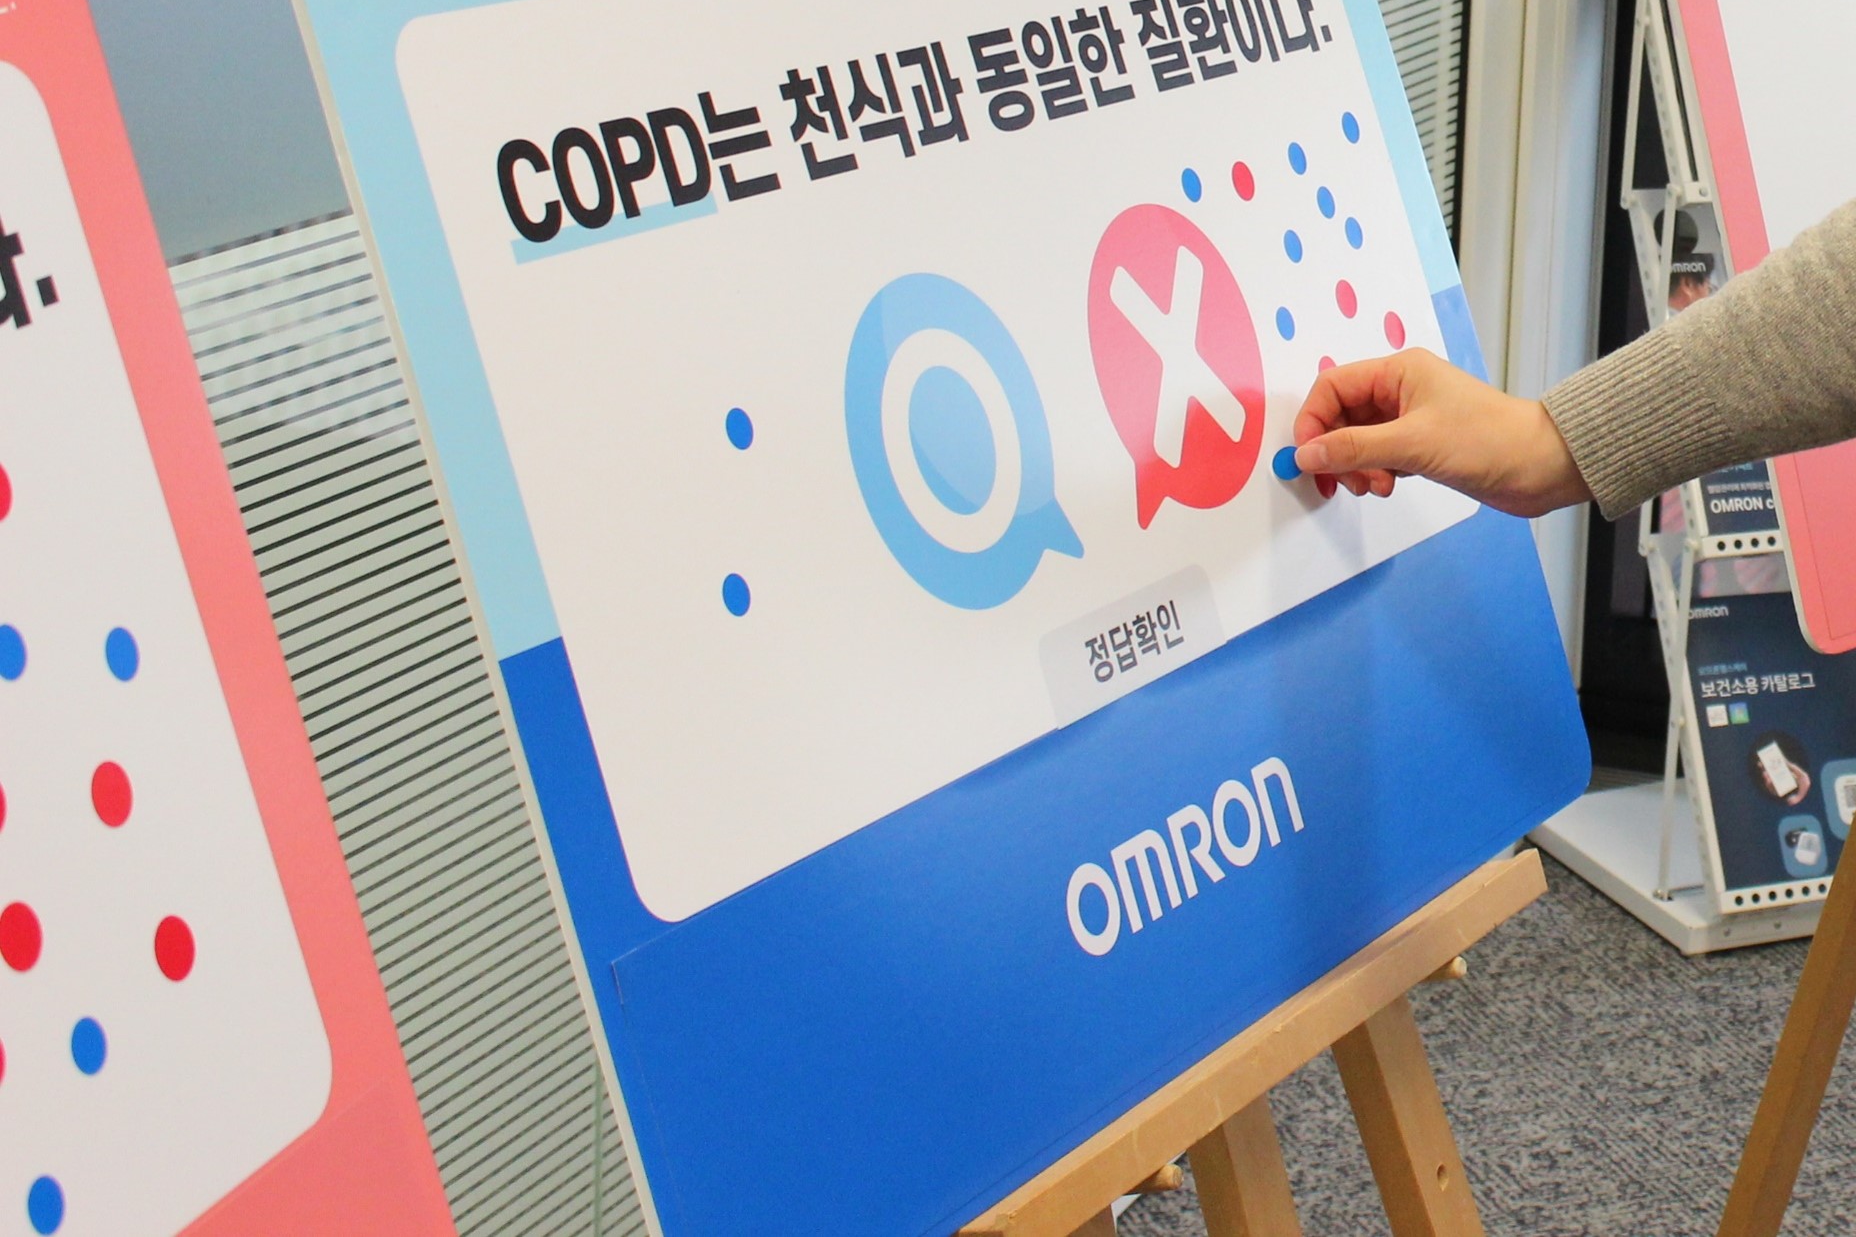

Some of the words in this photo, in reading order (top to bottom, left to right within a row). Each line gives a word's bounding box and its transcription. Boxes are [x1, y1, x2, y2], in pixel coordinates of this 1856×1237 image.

[495, 91, 782, 244] COPD는
[778, 40, 970, 181] 천식과
[966, 5, 1136, 133] 동일한
[1671, 262, 1706, 273] MRON
[1710, 496, 1764, 514] OMRON
[1084, 600, 1185, 683] 정답확인
[1701, 675, 1759, 698] 보건소용
[1760, 672, 1816, 694] 카탈로그
[1066, 756, 1306, 957] OMRON
